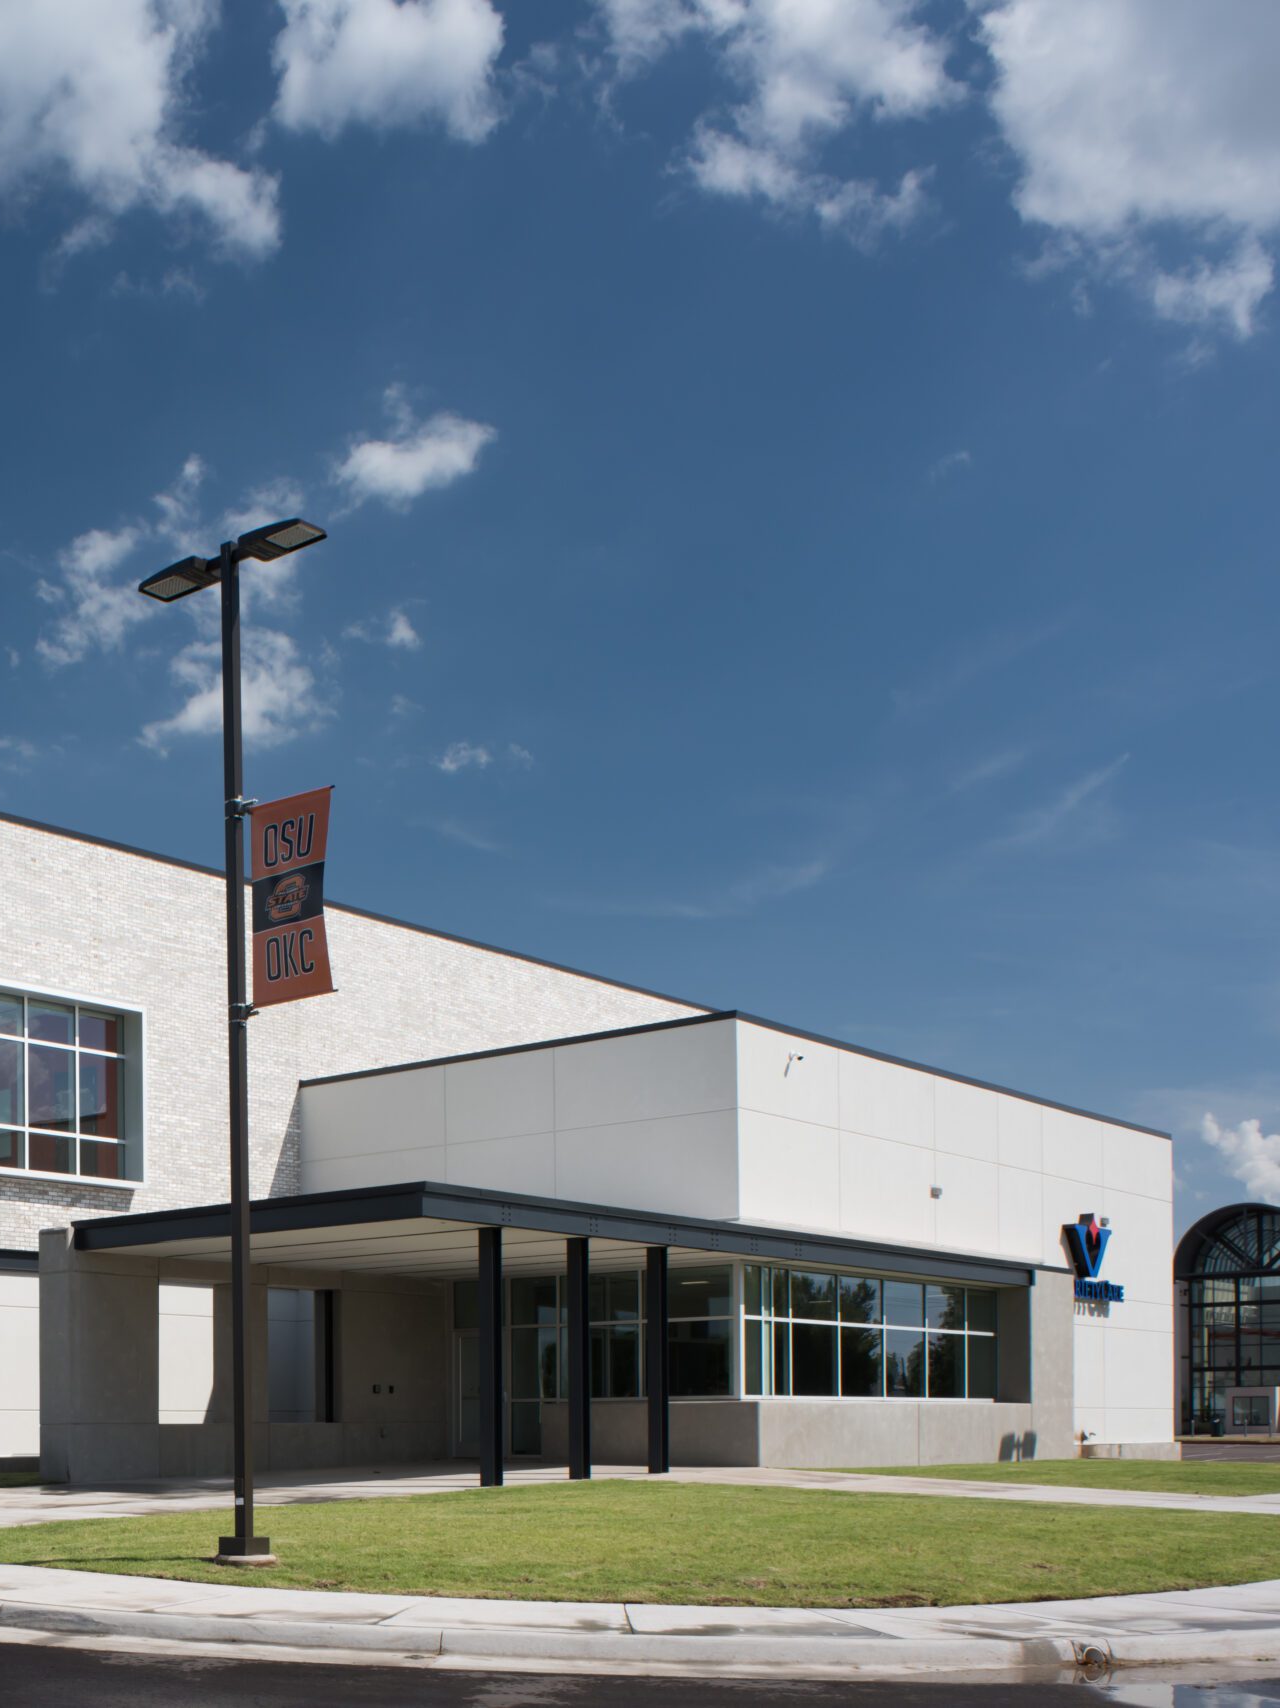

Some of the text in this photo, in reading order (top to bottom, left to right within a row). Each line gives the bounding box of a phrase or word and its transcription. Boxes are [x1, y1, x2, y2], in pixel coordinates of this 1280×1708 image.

[263, 813, 316, 869] OSU
[267, 889, 306, 909] STATE
[265, 927, 316, 983] OKC
